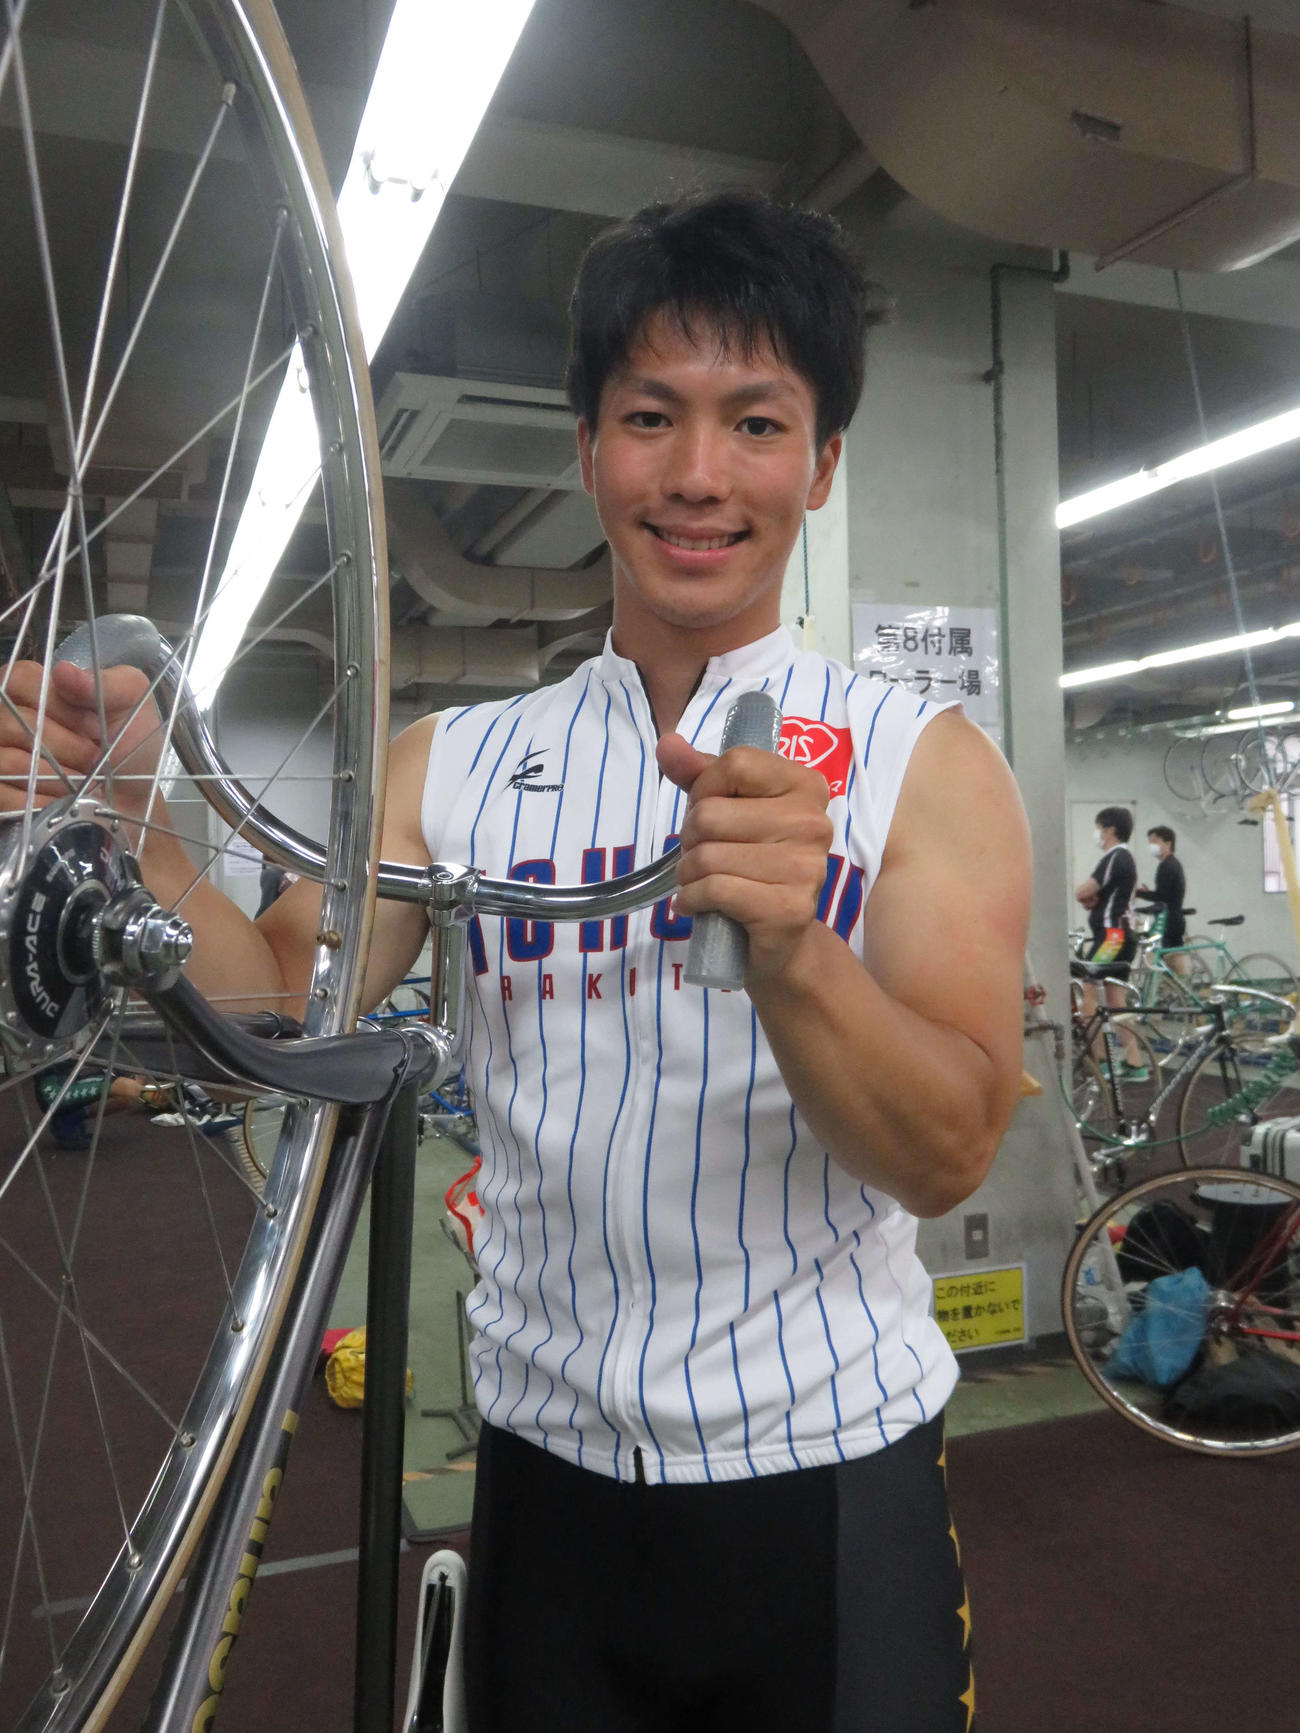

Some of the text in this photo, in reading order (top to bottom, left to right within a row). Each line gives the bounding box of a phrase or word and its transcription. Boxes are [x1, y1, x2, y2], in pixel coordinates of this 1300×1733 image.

[25, 891, 59, 1018] DURA-ACE
[936, 1281, 996, 1299] この付近に
